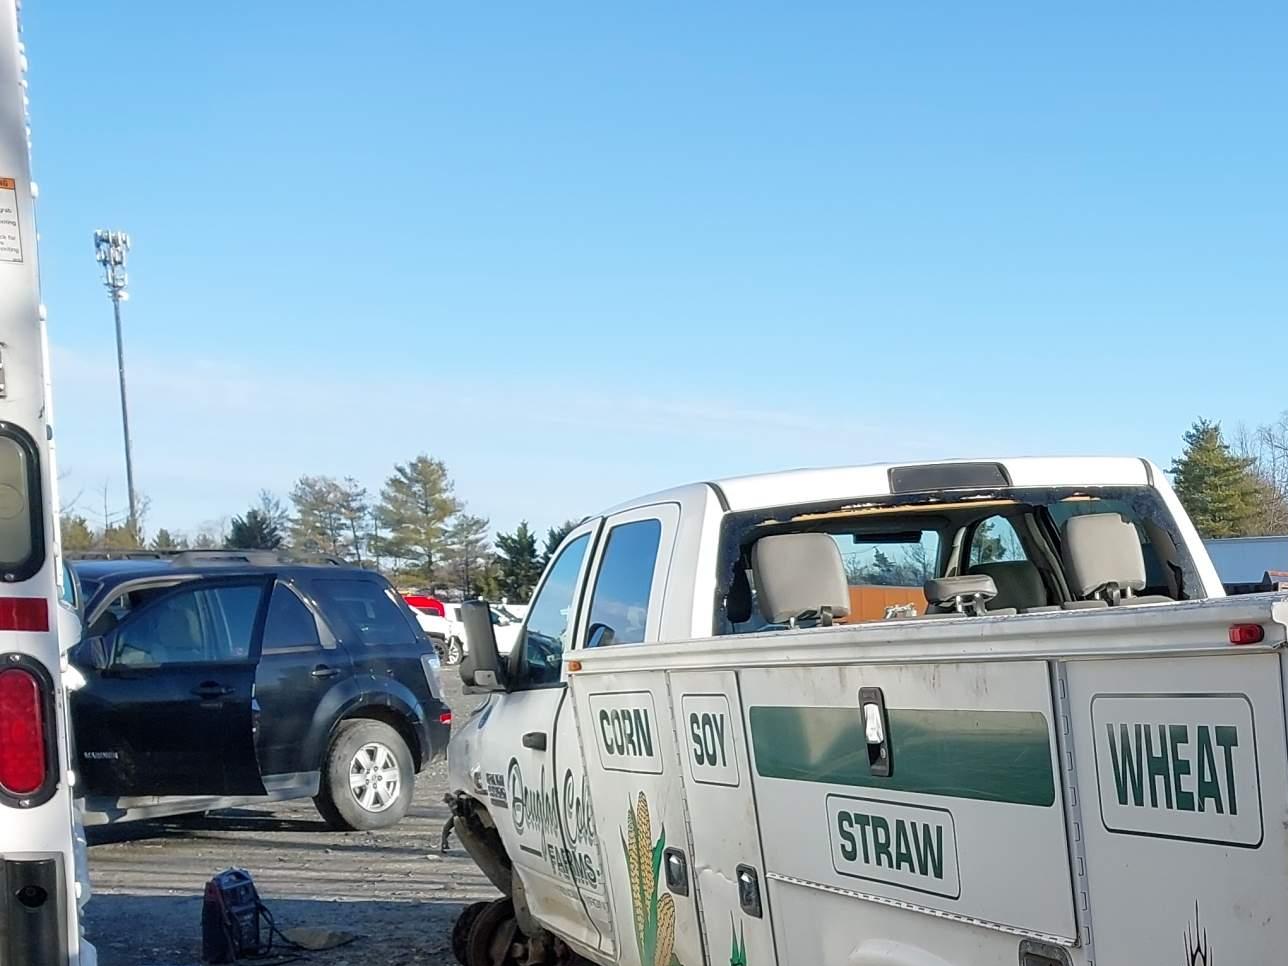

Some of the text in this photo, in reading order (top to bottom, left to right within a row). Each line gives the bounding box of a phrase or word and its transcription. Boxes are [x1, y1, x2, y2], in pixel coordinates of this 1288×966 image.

[600, 708, 654, 757] CORN
[690, 712, 728, 767] SOY
[1106, 723, 1239, 816] WHEAT
[837, 810, 944, 880] STRAW
